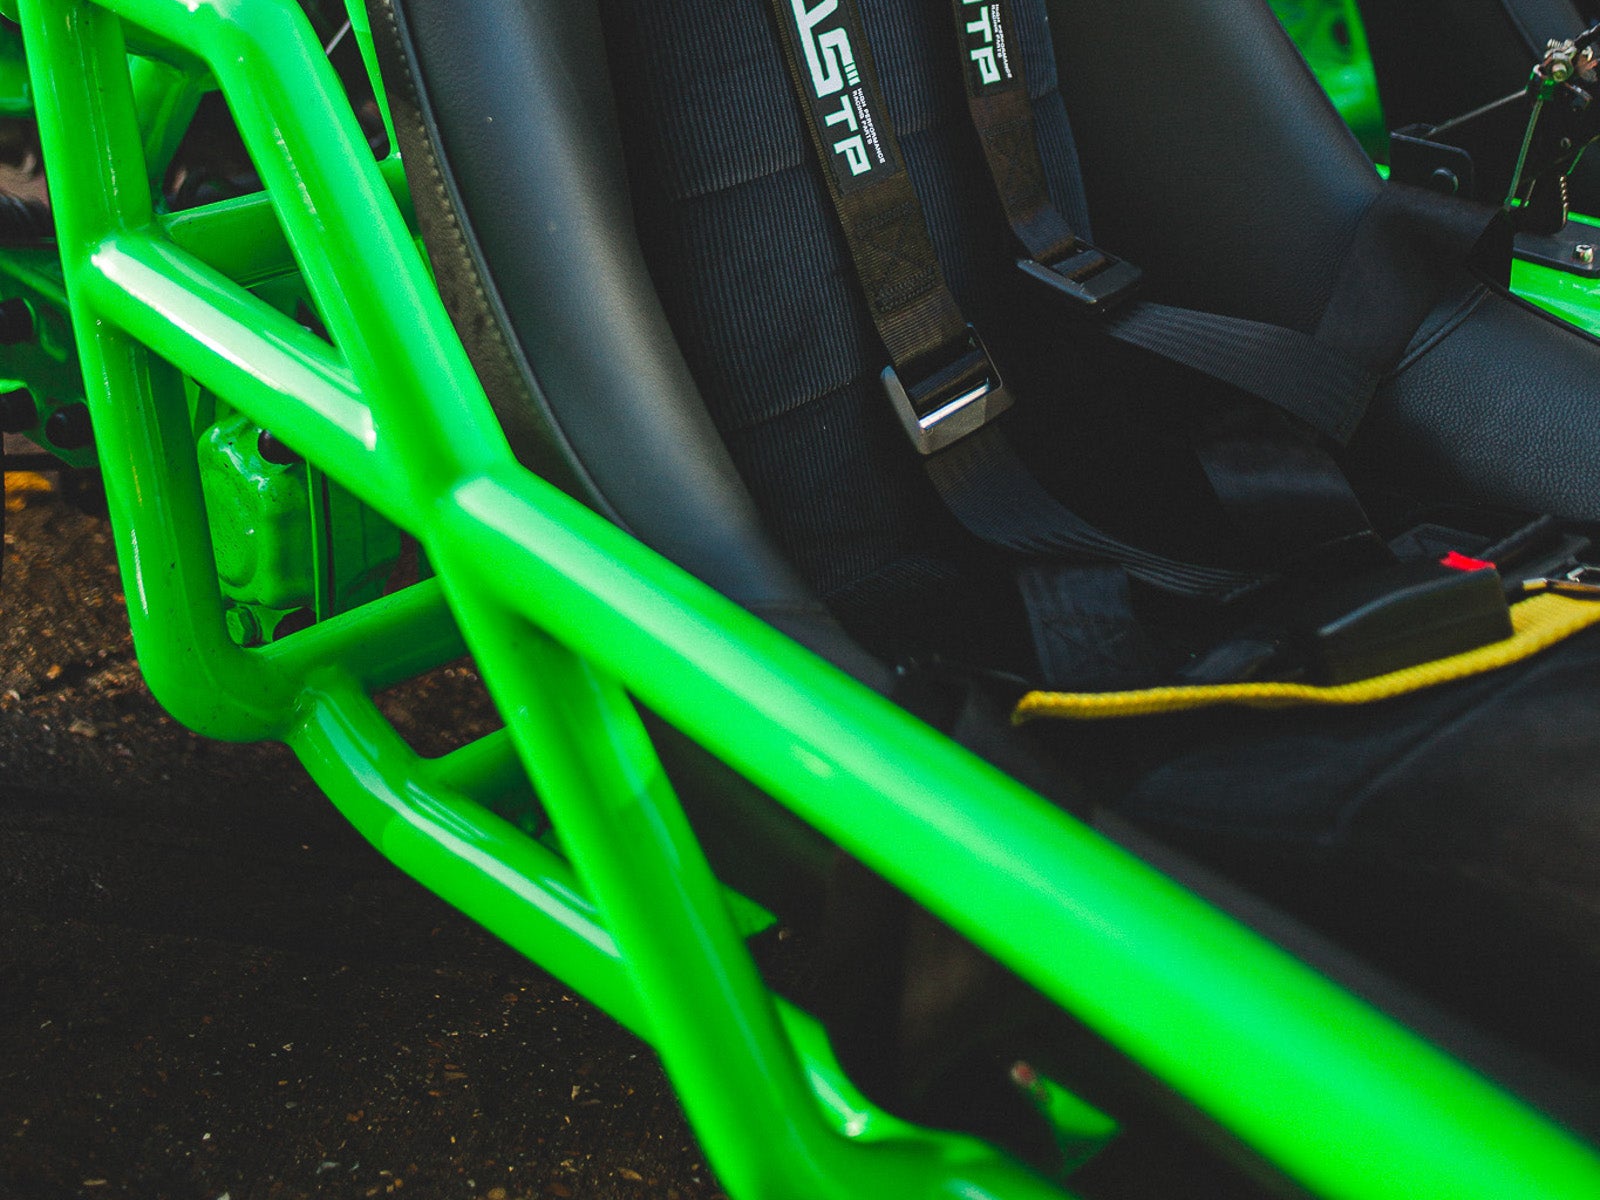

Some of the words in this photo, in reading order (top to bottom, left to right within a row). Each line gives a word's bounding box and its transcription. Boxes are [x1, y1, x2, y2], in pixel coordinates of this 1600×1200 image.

[852, 89, 865, 120] RACING
[861, 120, 872, 145] PARTS
[857, 87, 867, 107] HIGH
[864, 108, 886, 164] PERFORMANCE
